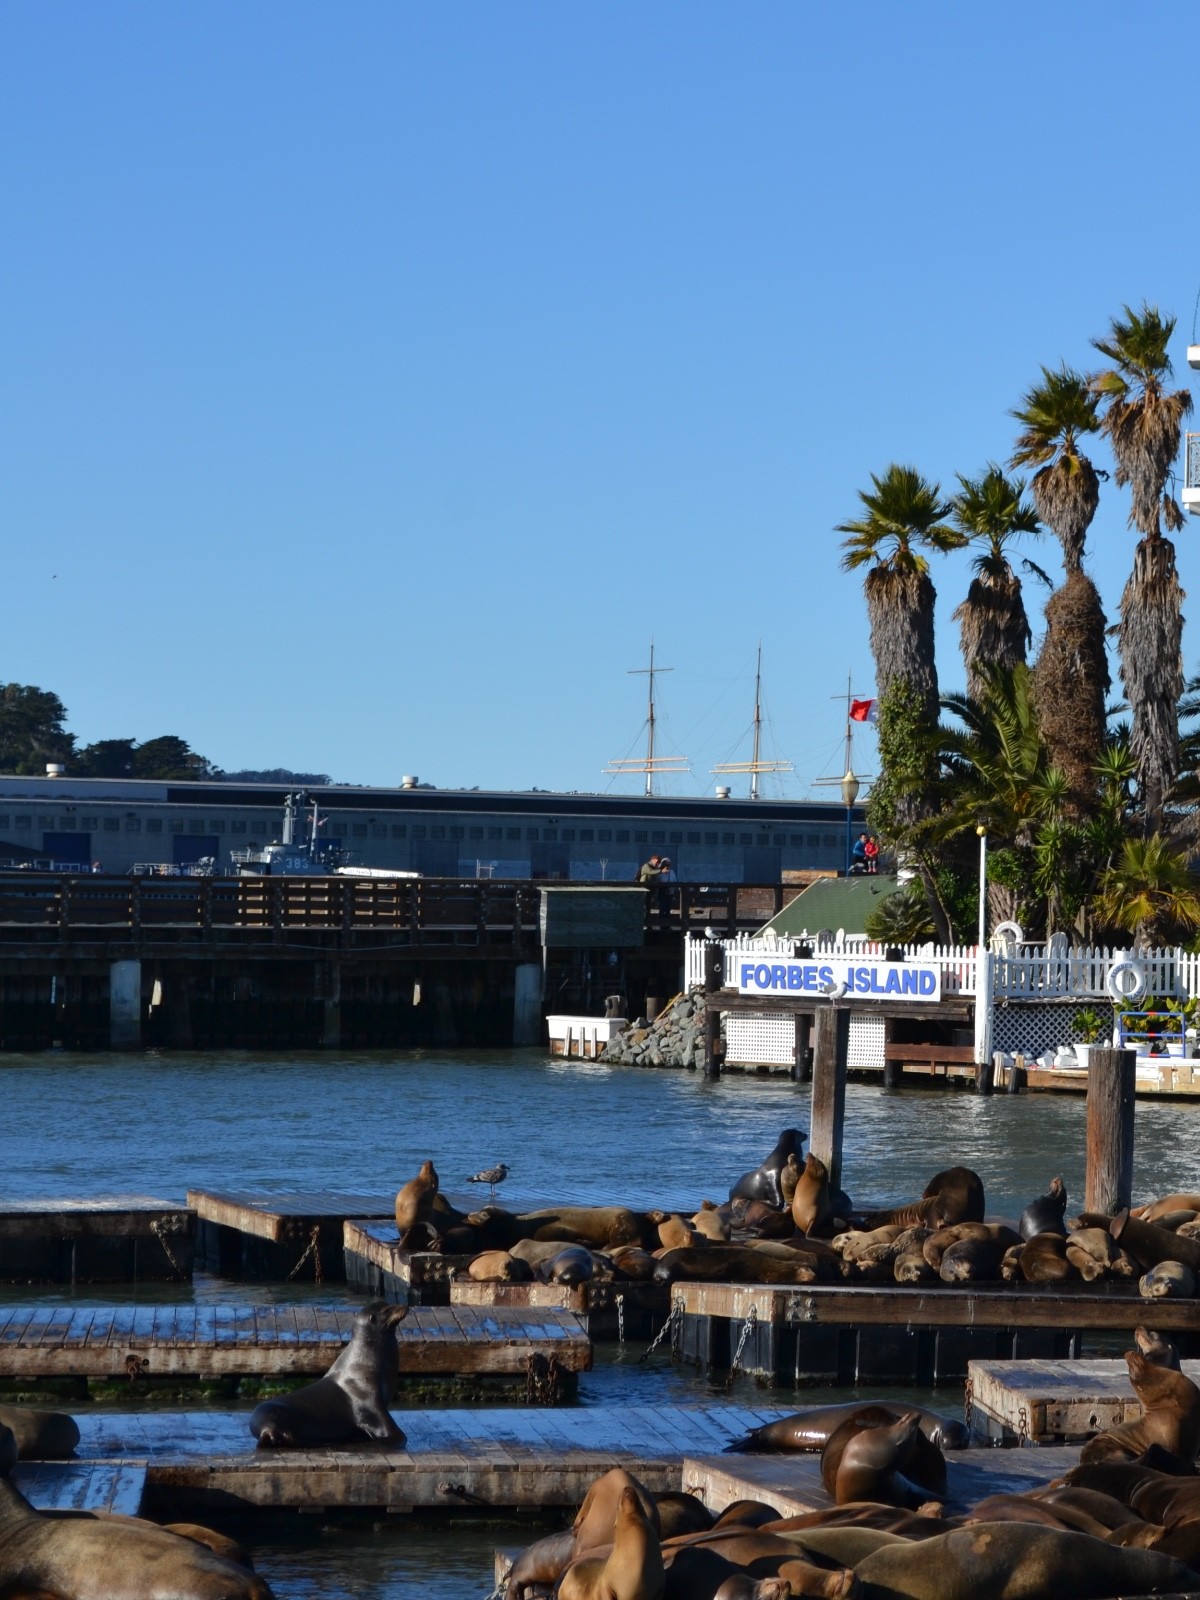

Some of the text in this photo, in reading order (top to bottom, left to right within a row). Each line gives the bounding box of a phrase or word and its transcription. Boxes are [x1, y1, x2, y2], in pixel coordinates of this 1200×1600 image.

[286, 858, 308, 869] 383
[741, 963, 937, 996] FORBES ISLAND
